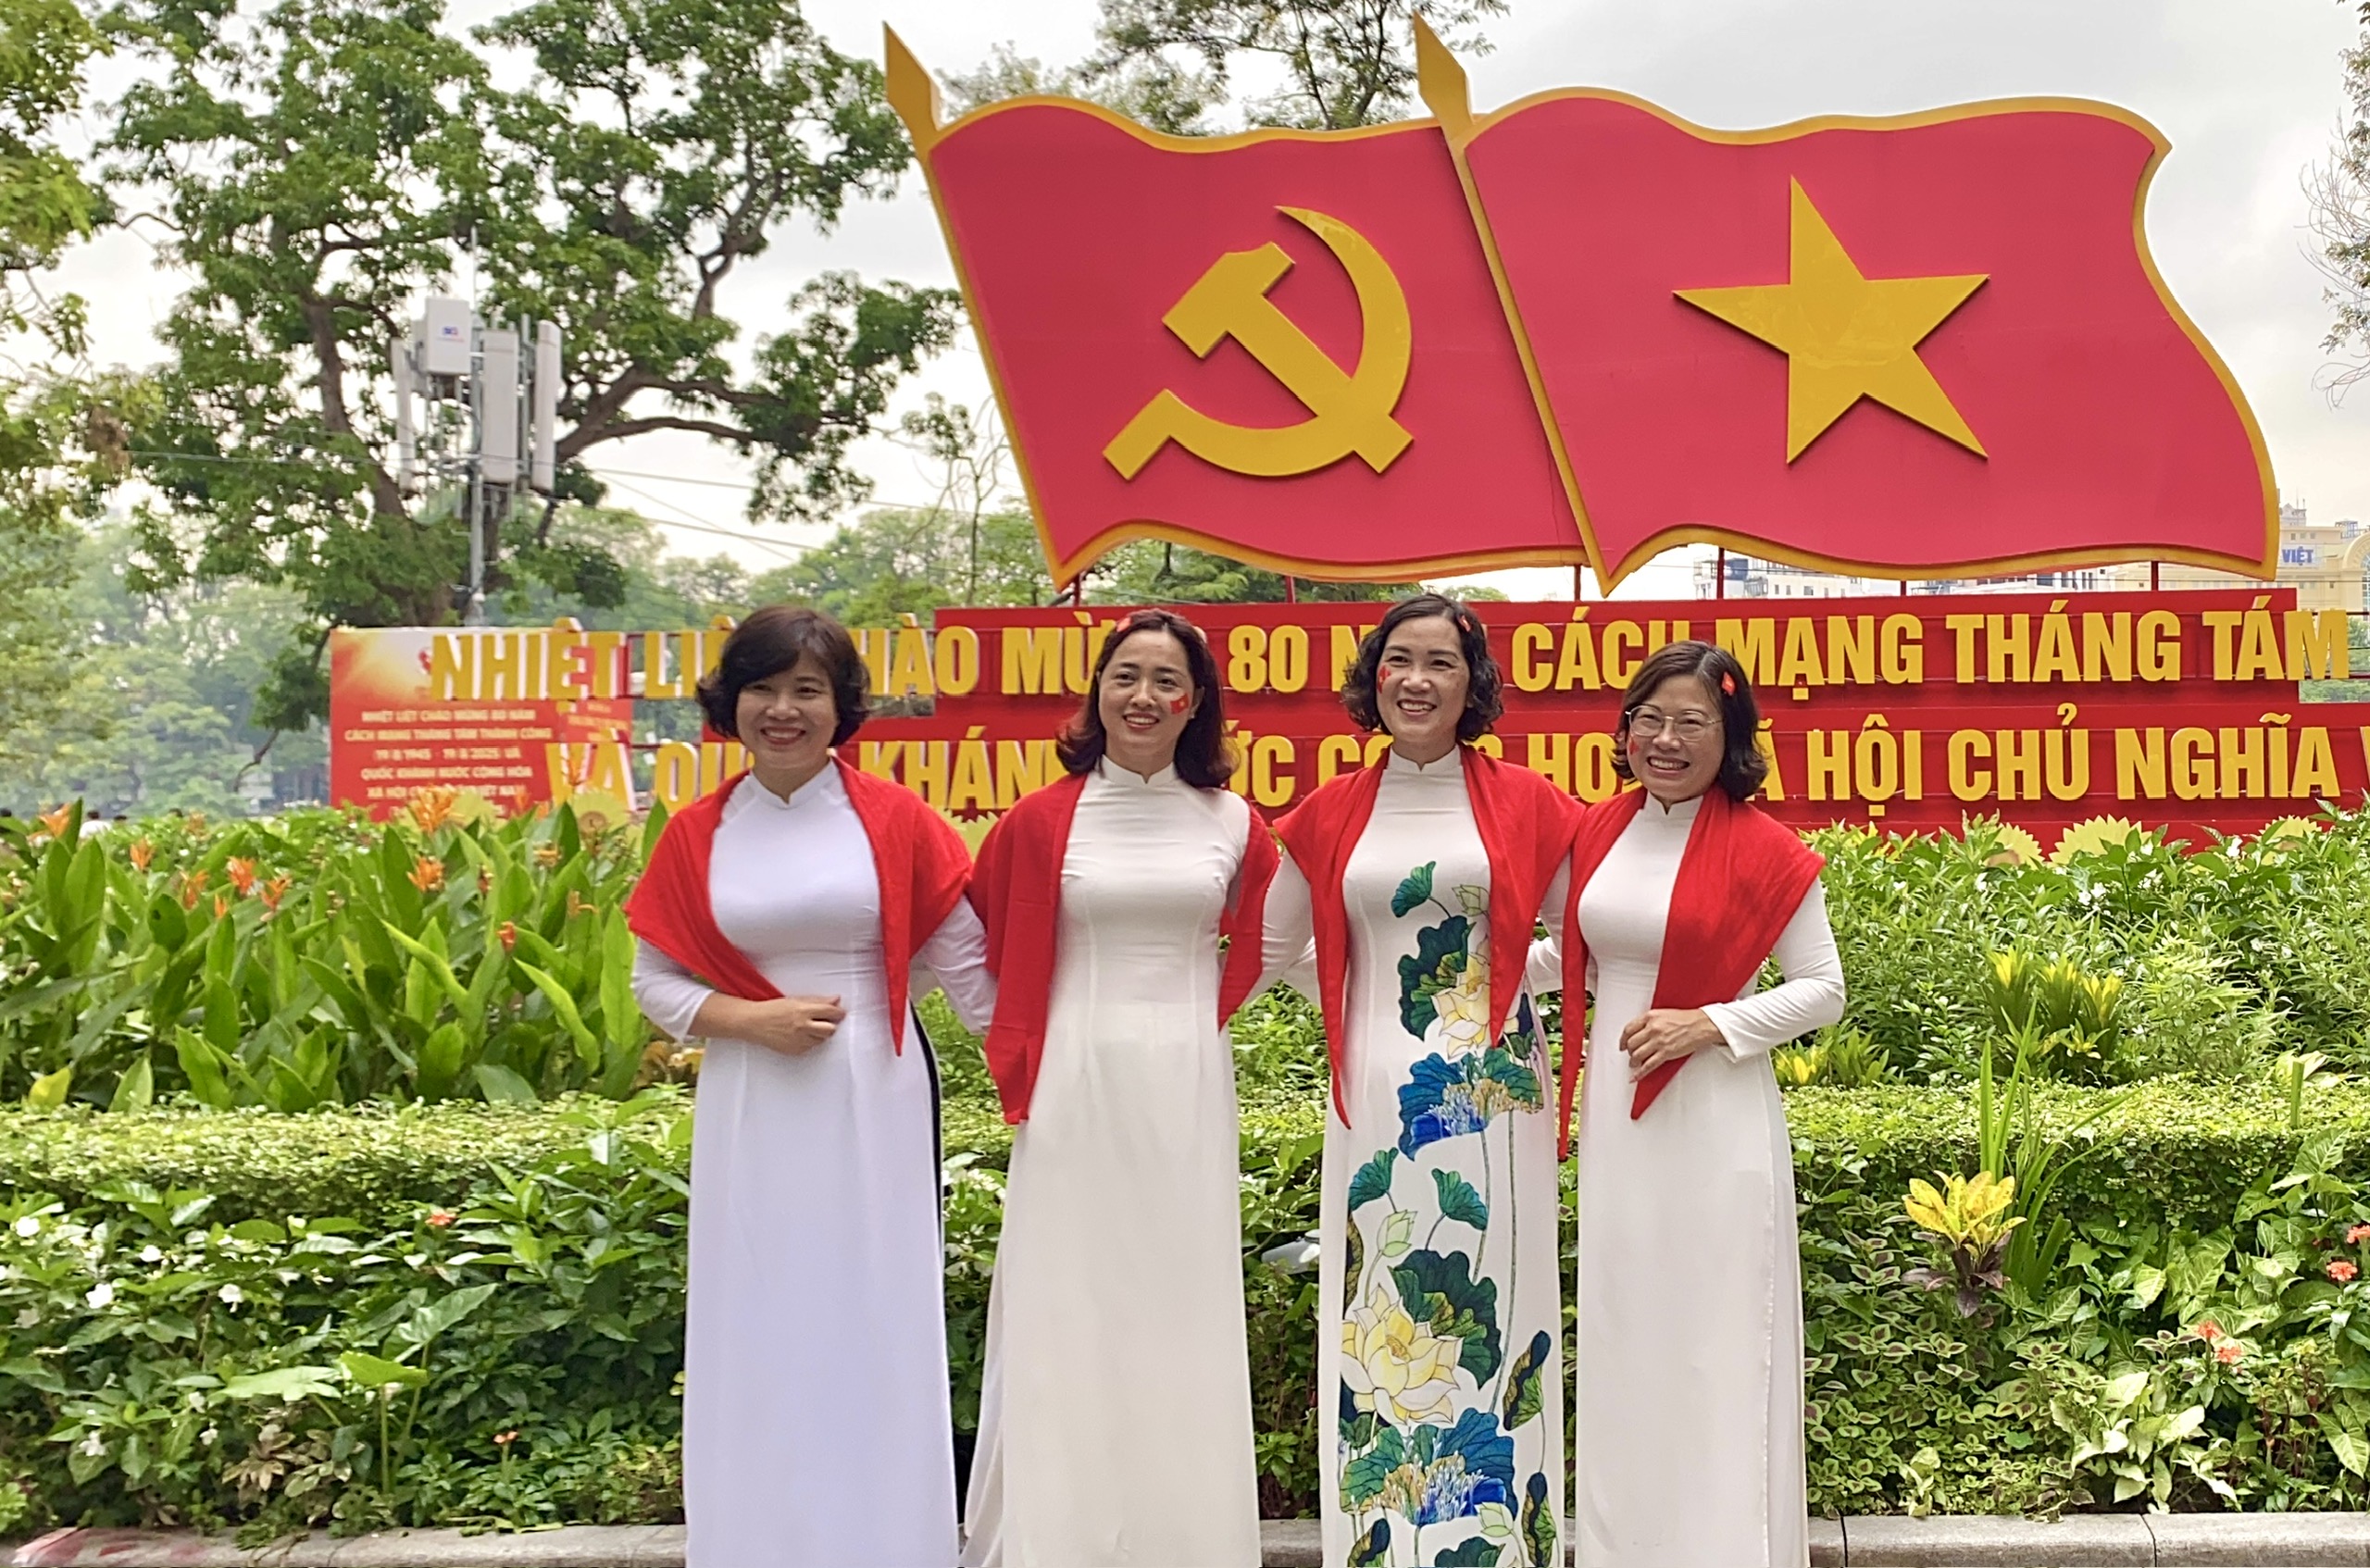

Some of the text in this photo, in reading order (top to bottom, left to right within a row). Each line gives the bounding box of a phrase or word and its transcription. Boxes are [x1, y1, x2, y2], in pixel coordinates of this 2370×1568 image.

[2281, 546, 2314, 566] VIỆT
[430, 617, 623, 714] NHIỆT
[849, 612, 980, 695] HÀO
[1228, 625, 1309, 693] 80
[1715, 616, 1923, 701] MẠNG
[1946, 599, 2181, 683] THÁNG
[2202, 595, 2350, 681] TÁM
[1806, 714, 1922, 816] HỘI
[1948, 703, 2089, 802] CHỦ
[2115, 712, 2341, 799] NGHĨA
